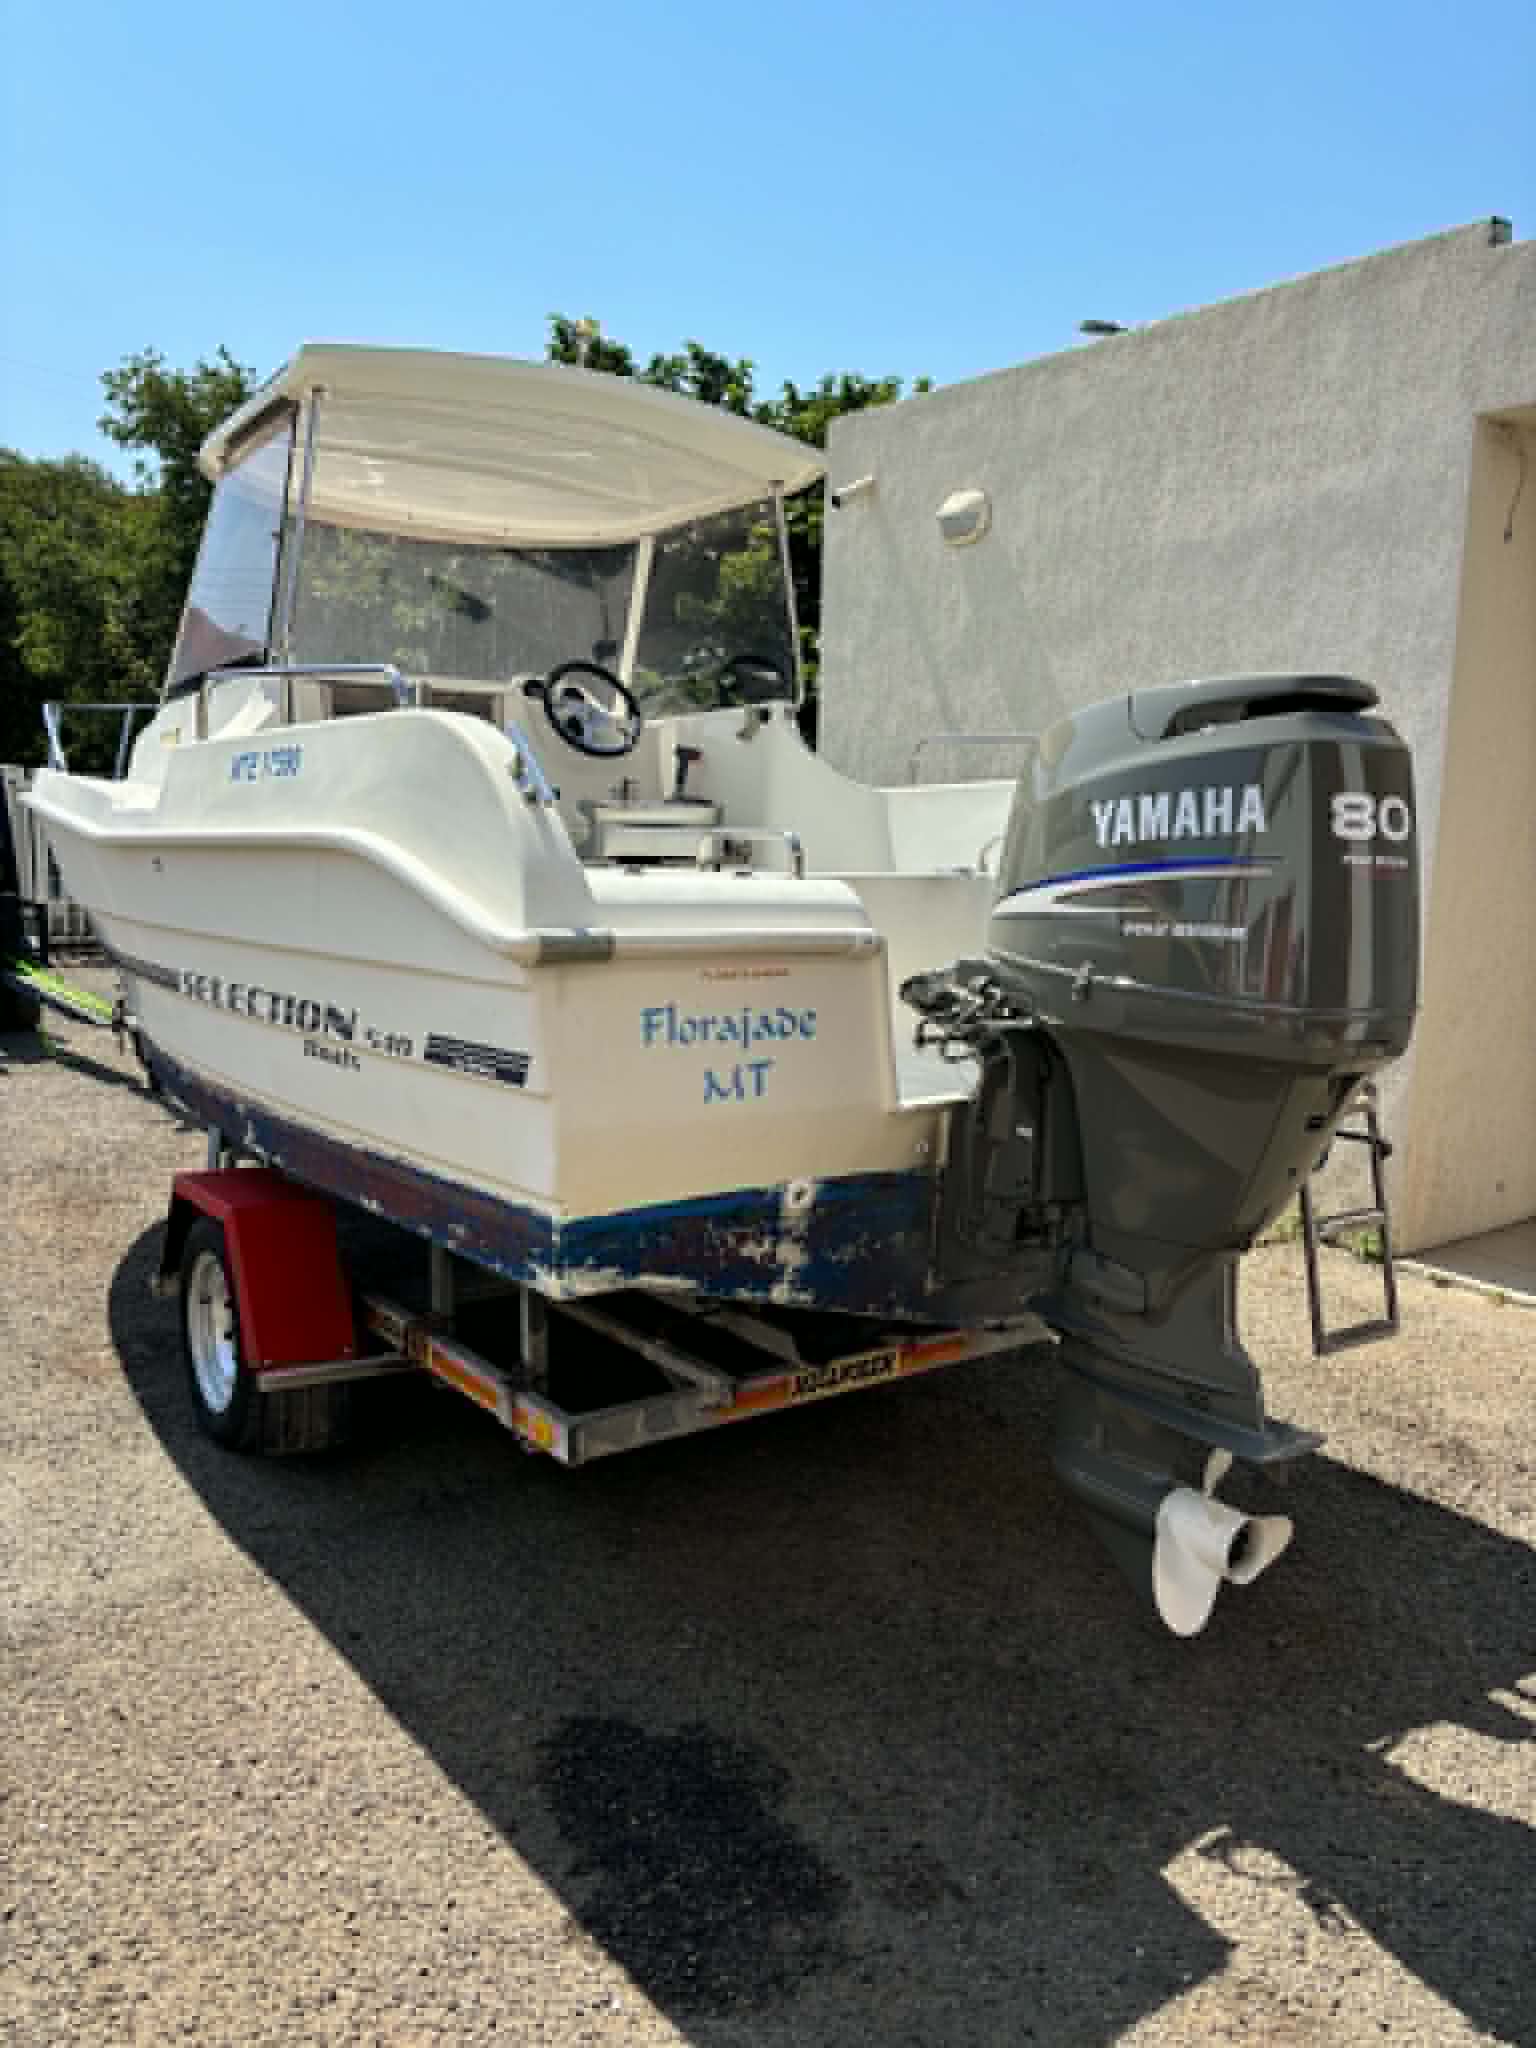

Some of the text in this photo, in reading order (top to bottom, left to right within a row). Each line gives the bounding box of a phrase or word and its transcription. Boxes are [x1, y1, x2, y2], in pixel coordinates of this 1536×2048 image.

[1092, 783, 1267, 848] YAMAHA
[1330, 792, 1411, 843] 80
[181, 970, 357, 1042] SELECTION
[640, 1002, 817, 1049] Florajade
[704, 1058, 776, 1104] MT
